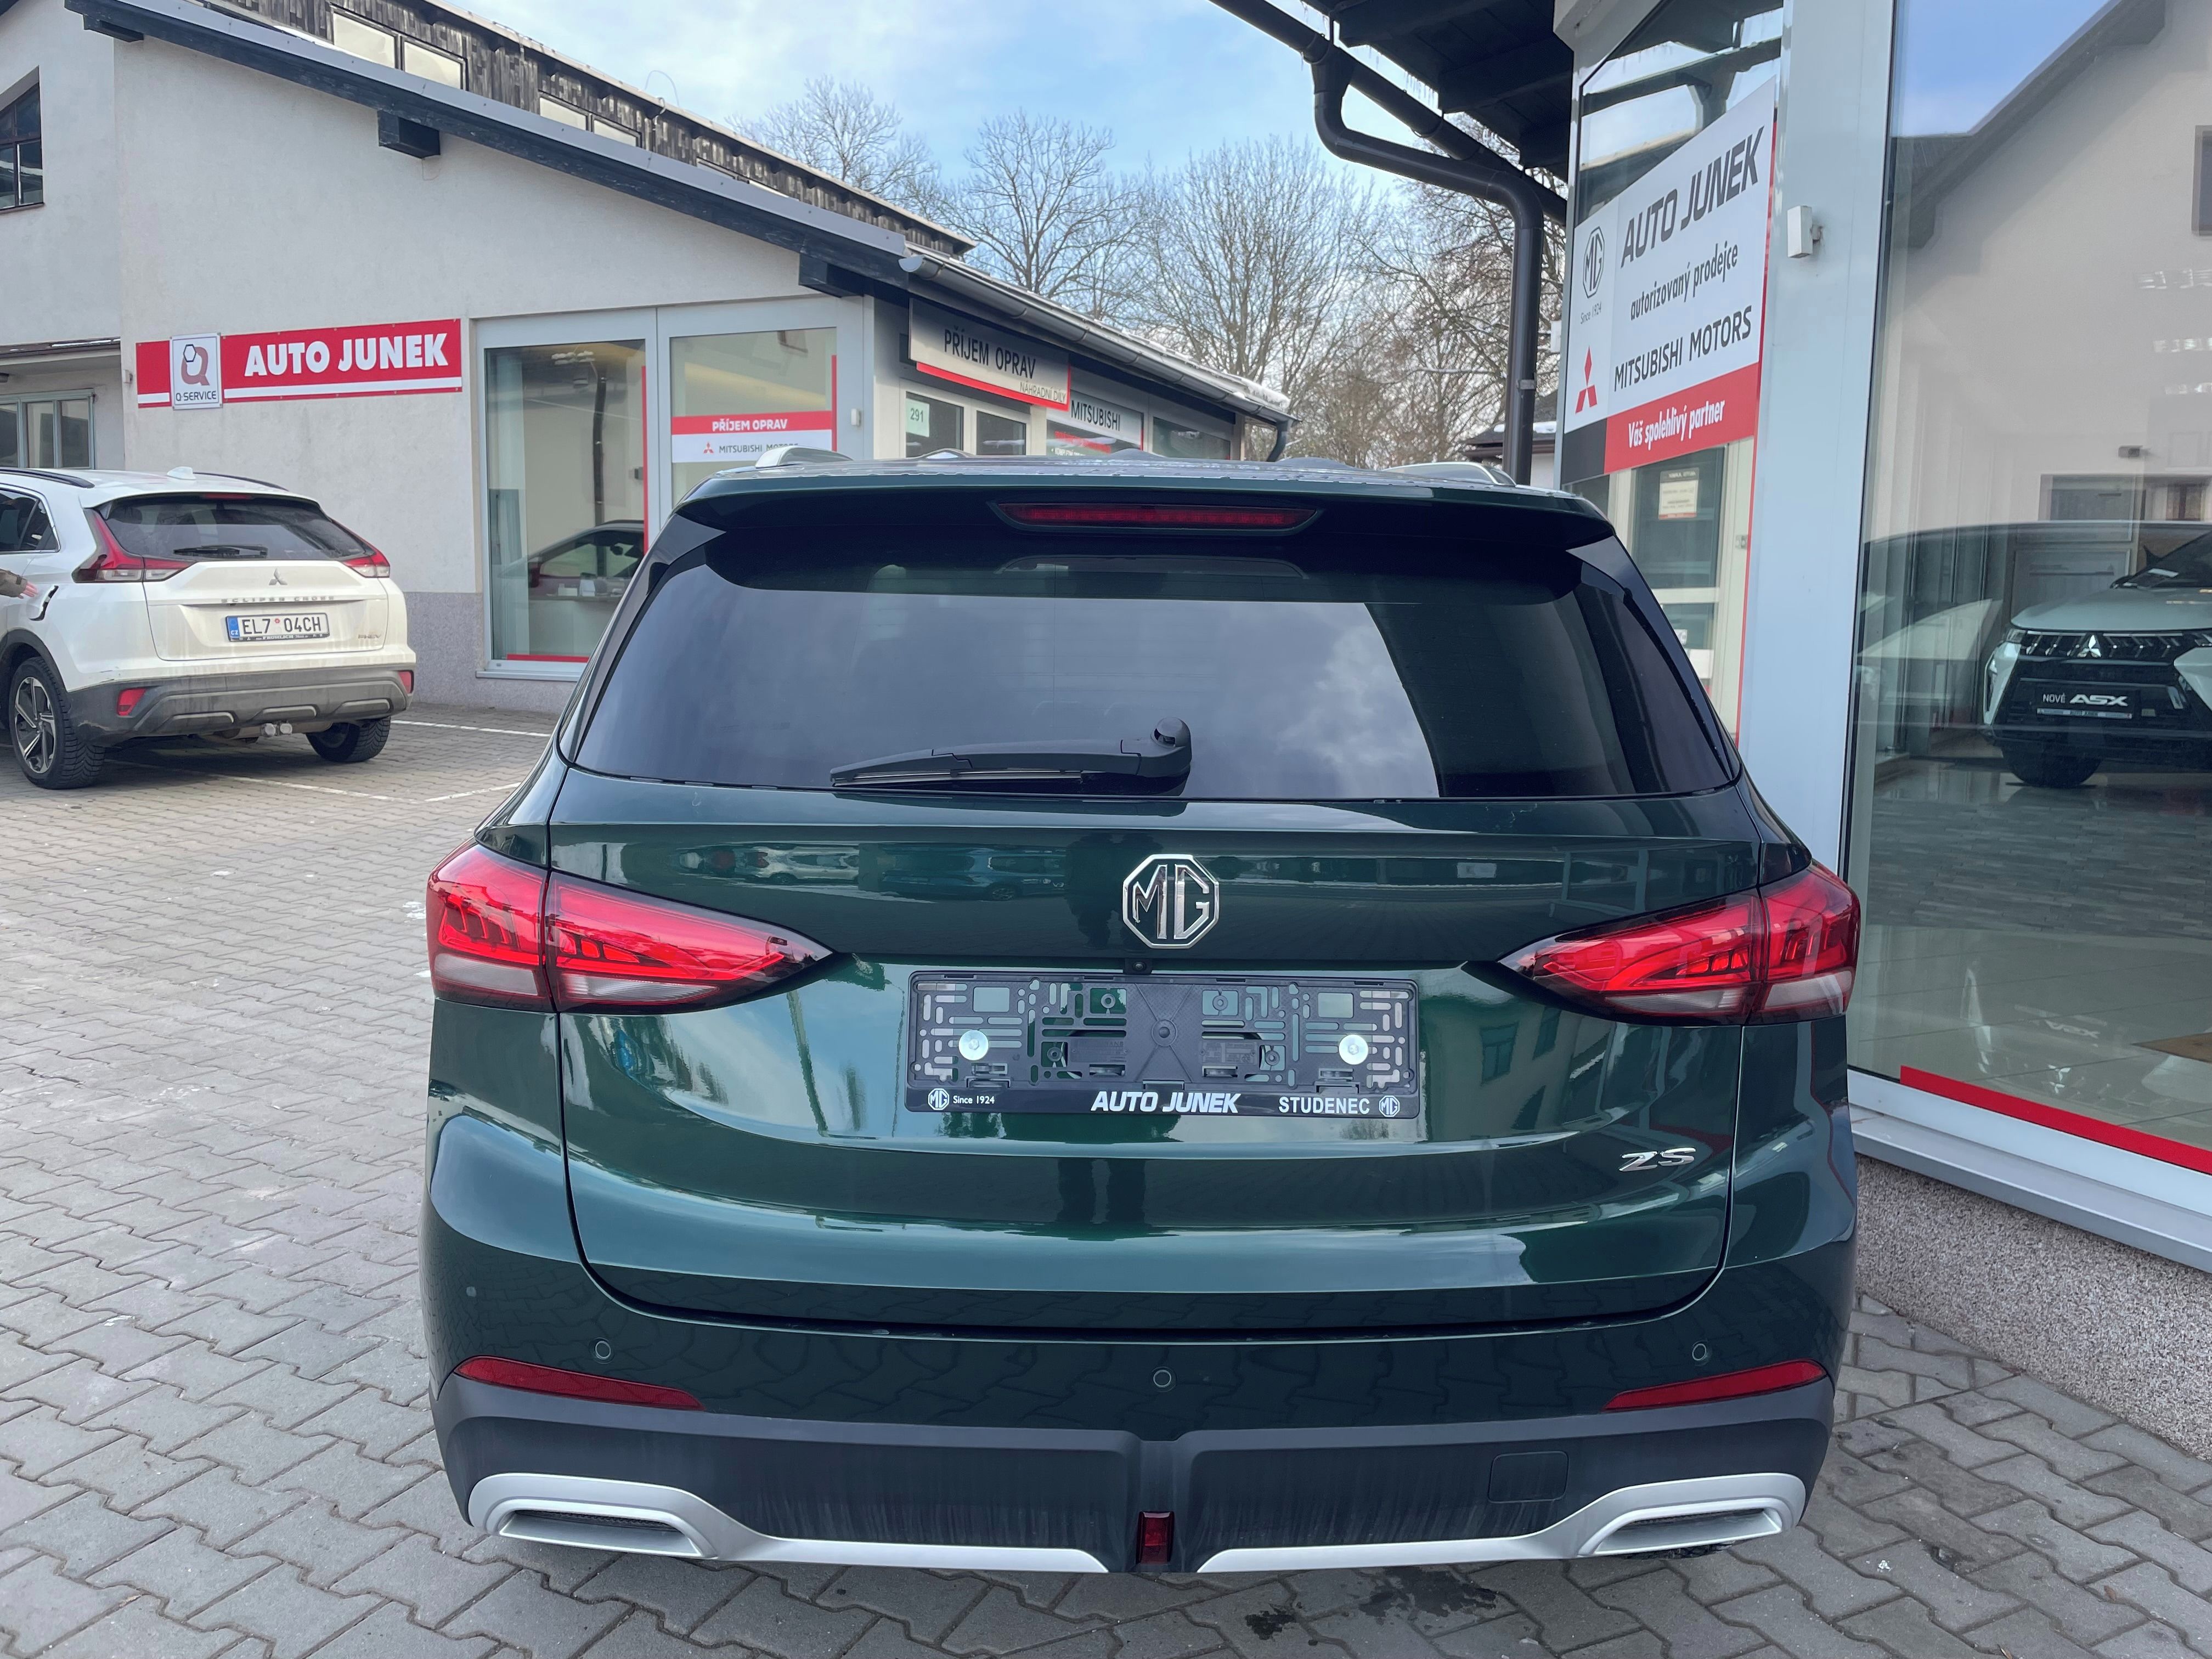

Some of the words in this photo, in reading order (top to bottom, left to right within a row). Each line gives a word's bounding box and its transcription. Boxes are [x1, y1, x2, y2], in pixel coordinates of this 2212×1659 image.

[1621, 189, 1678, 268] AUTO
[1680, 125, 1765, 231] JUNEK
[1584, 230, 1604, 294] MG
[1630, 262, 1690, 321] autorizovaný
[1692, 240, 1738, 298] prodejce
[1581, 311, 1591, 324] Since
[1592, 301, 1602, 318] 1924
[244, 341, 330, 376] AUTO
[337, 333, 449, 372] JUNEK
[944, 325, 989, 366] PŘÍJEM
[996, 347, 1036, 379] OPRAV
[1614, 336, 1683, 392] MITSUBISHI
[1689, 305, 1752, 362] MOTORS
[1019, 381, 1053, 400] NÁHRADNÍ
[1053, 387, 1066, 403] DÍLY
[712, 418, 750, 432] PŘÍJEM
[752, 419, 788, 431] OPRAV
[910, 408, 923, 423] 291
[1071, 400, 1121, 431] MITSUBISHI
[1628, 420, 1644, 448] Váš
[1644, 404, 1688, 451] spolehlivý
[1689, 400, 1725, 439] partner
[719, 444, 763, 454] MITSUBISHI
[242, 618, 270, 634] EL7
[284, 617, 321, 632] 04CH
[2042, 692, 2066, 704] NOVÉ
[2069, 694, 2129, 707] ASX
[1127, 859, 1214, 944] MG
[929, 1090, 949, 1109] MG
[953, 1095, 973, 1104] Since
[977, 1095, 995, 1104] 1924
[1091, 1091, 1159, 1112] AUTO
[1162, 1092, 1242, 1114] JUNEK
[1278, 1096, 1370, 1114] STUDENEC
[1380, 1096, 1399, 1116] MG
[1619, 1147, 1696, 1172] ZS
